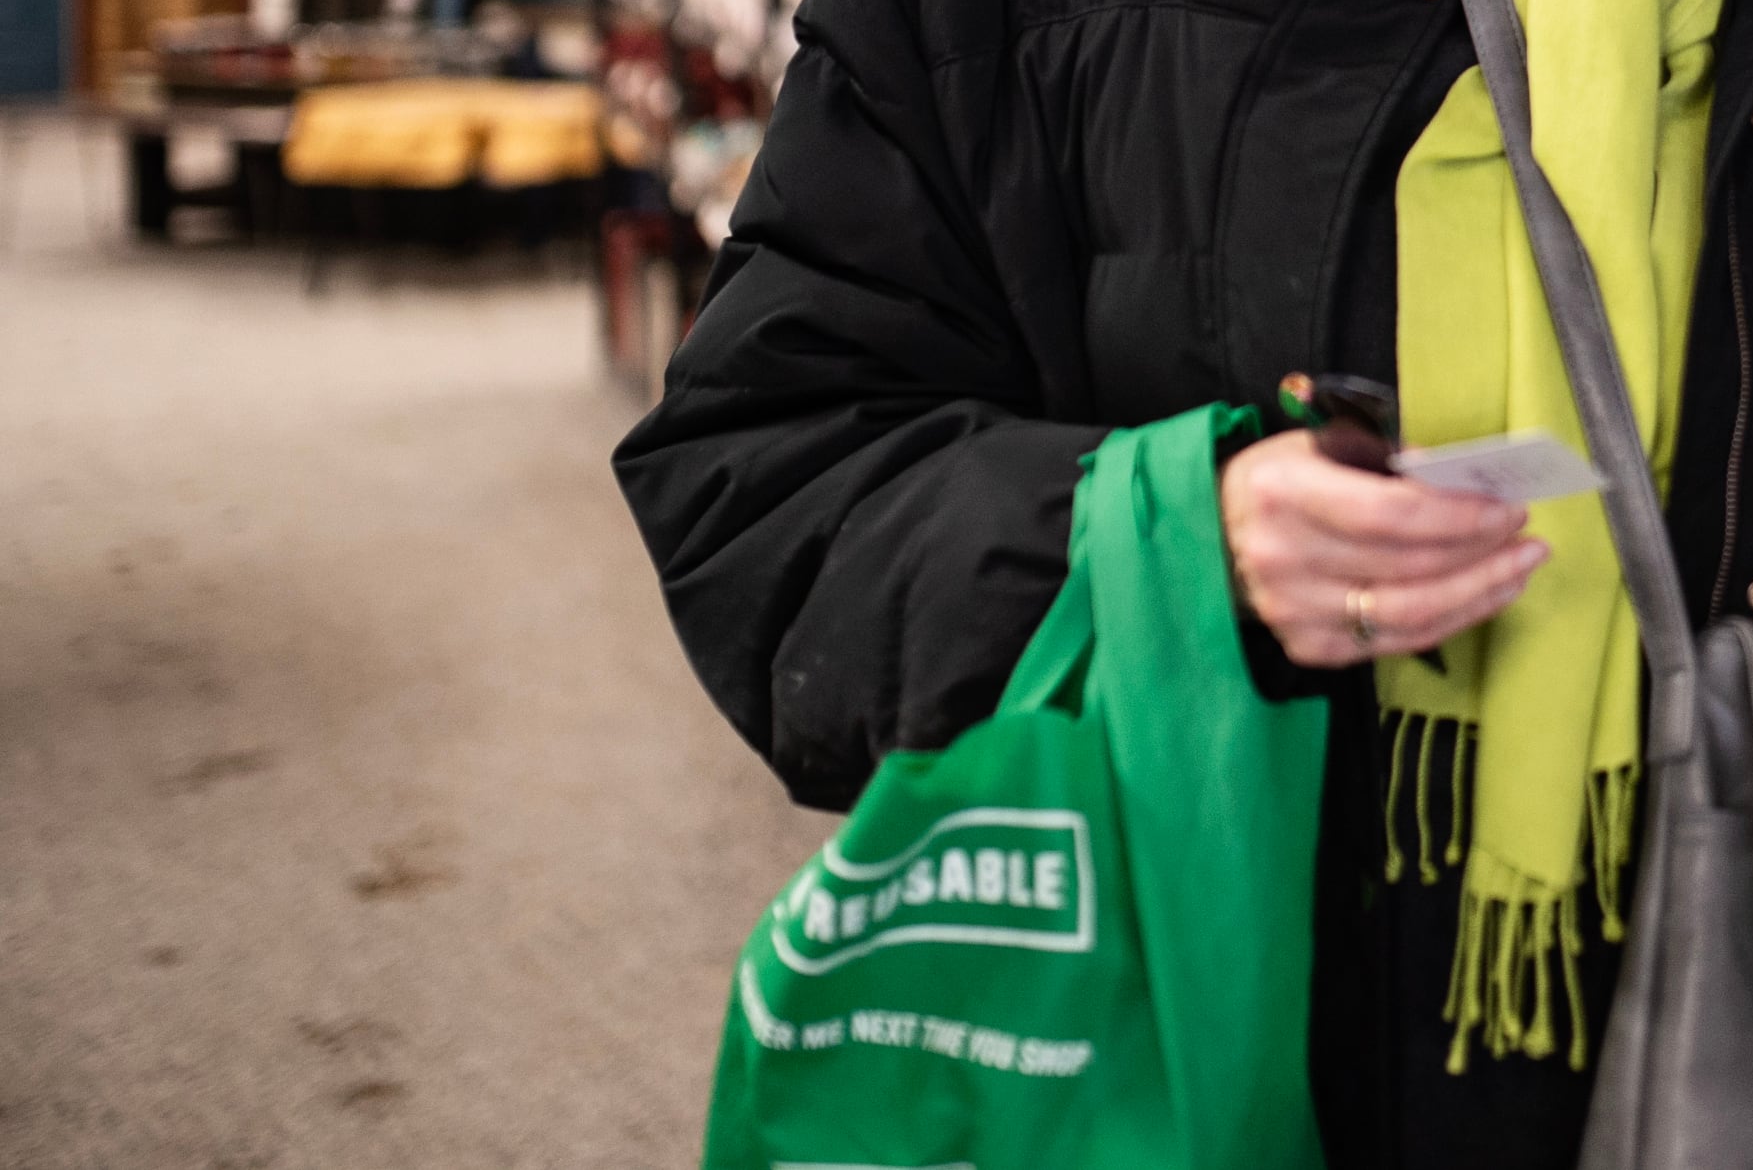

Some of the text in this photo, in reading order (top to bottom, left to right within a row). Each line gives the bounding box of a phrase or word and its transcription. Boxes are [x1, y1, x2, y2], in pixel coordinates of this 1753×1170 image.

[804, 848, 1067, 942] REUSABLE
[851, 1009, 920, 1048] NEXT
[968, 1024, 1019, 1072] YOU
[1017, 1036, 1093, 1078] SHOP
